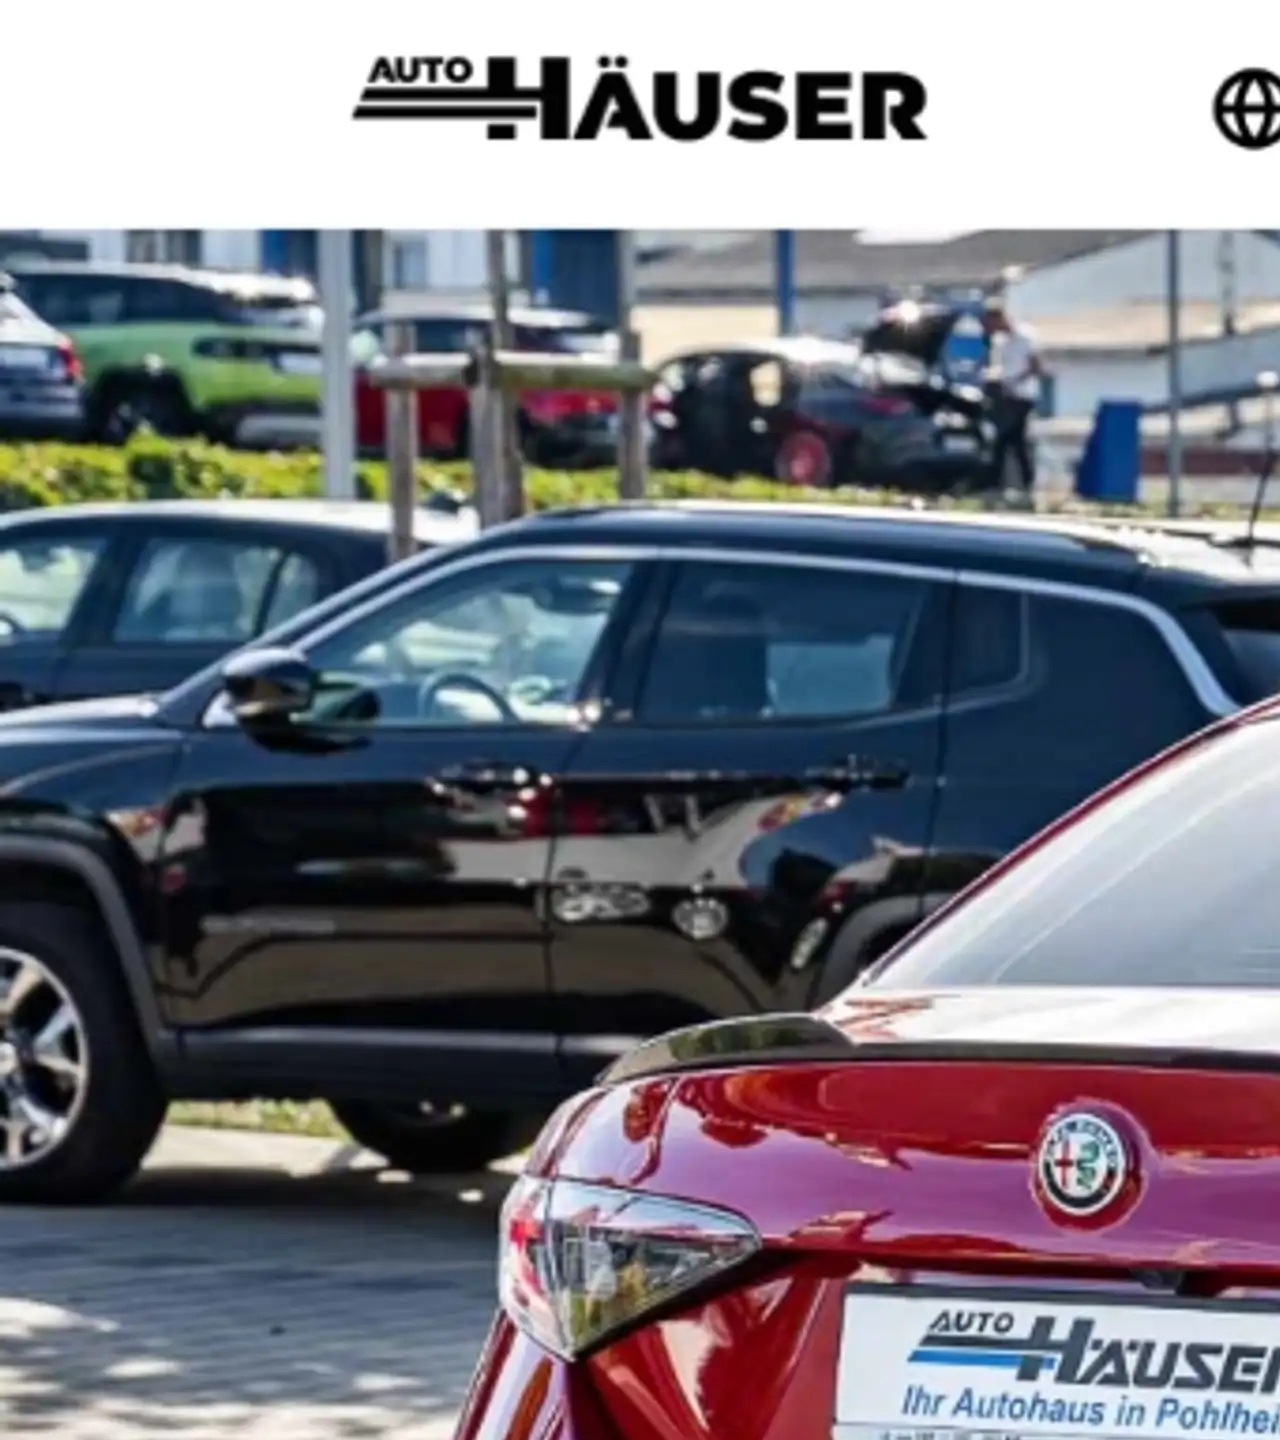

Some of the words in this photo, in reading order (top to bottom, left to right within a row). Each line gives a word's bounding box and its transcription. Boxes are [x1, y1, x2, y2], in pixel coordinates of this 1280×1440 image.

[928, 1310, 1014, 1335] AUTO
[901, 1384, 946, 1419] Ihr
[952, 1386, 1105, 1428] Autohaus
[1116, 1392, 1147, 1428] in
